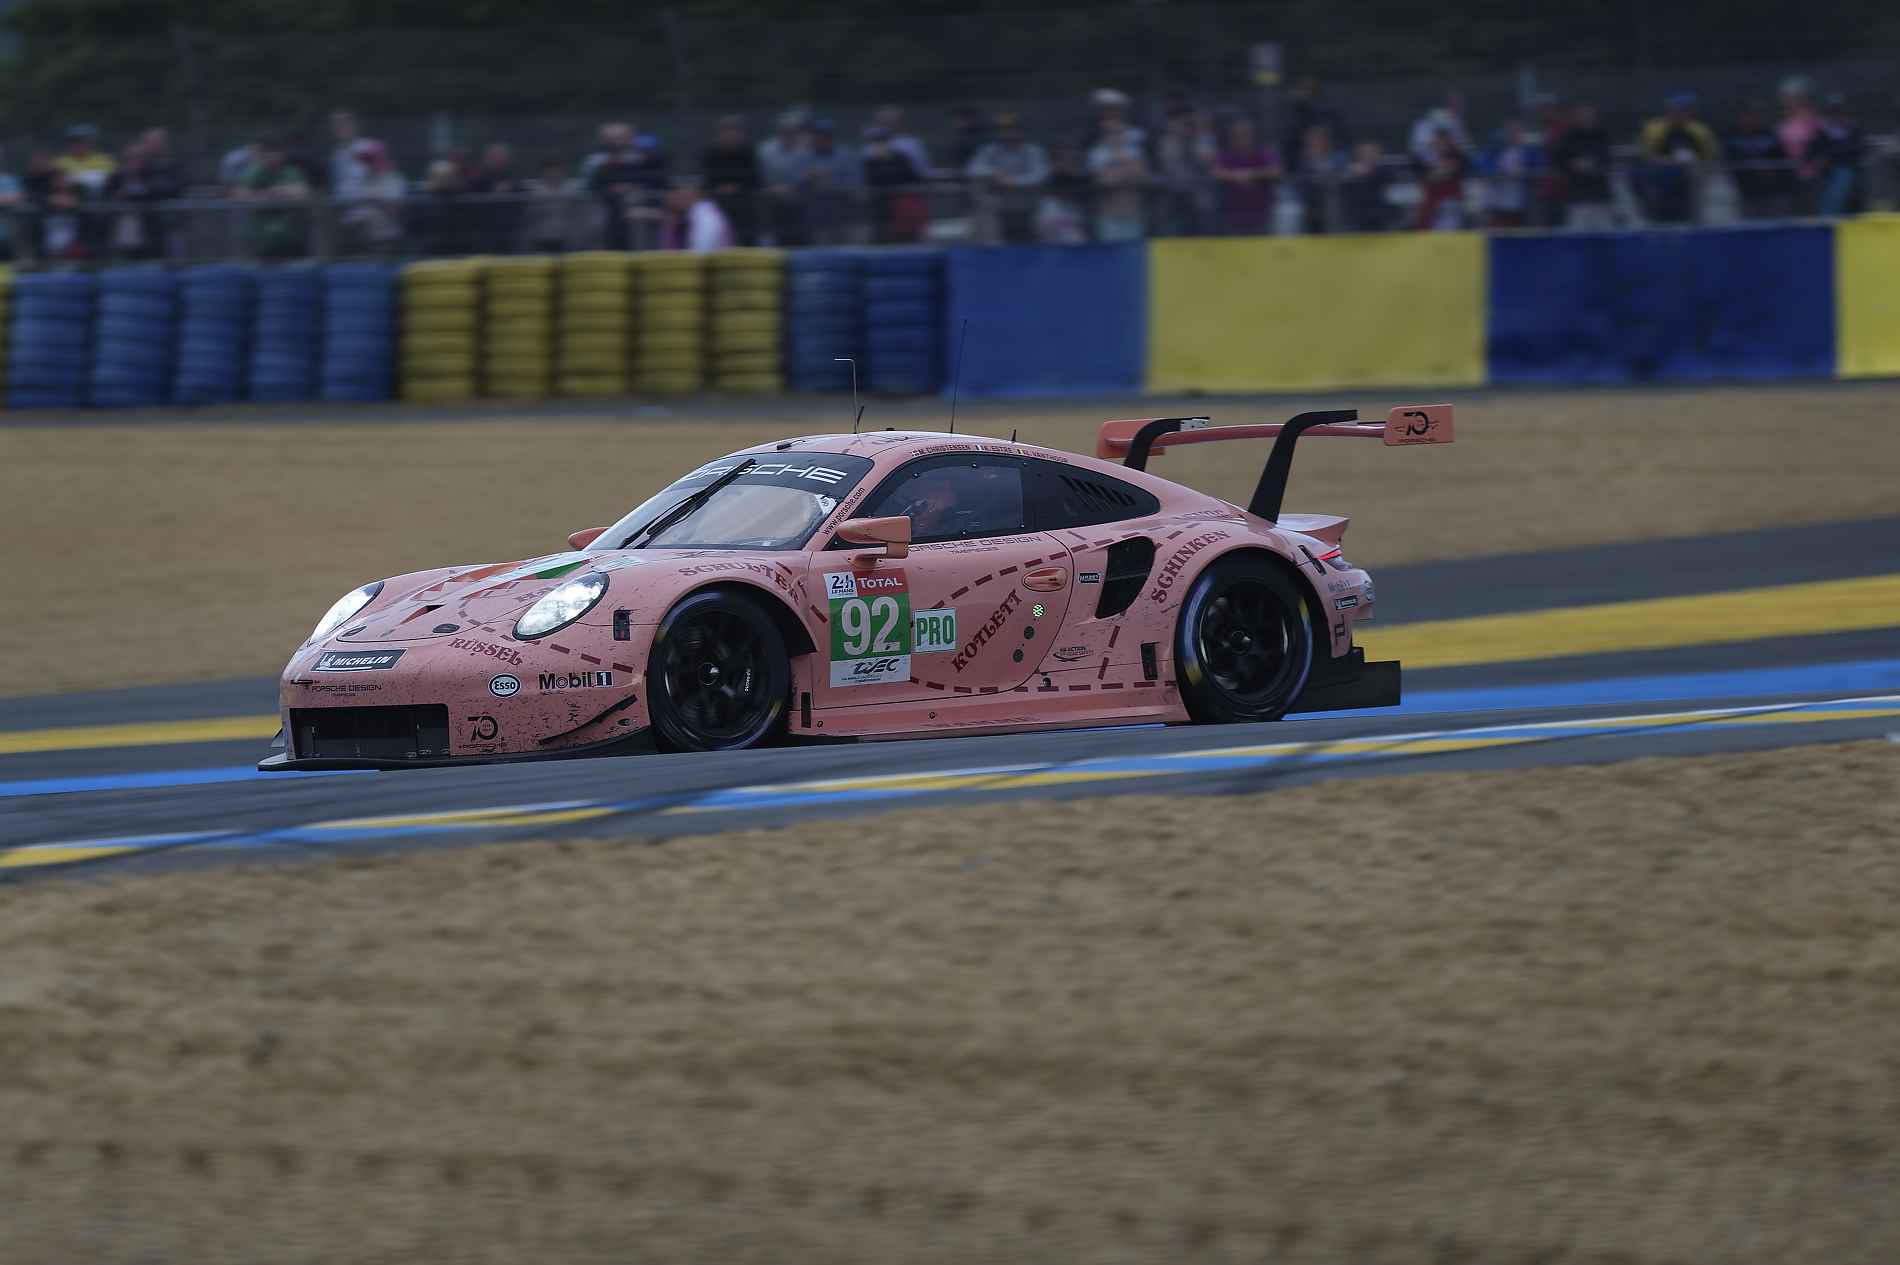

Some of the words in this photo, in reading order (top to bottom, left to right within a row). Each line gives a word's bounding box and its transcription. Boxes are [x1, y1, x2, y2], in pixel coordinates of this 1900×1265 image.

[823, 486, 866, 536] www.porsche.com
[909, 540, 977, 553] ORSCHE
[841, 596, 901, 656] 92
[916, 615, 955, 647] PRO
[951, 589, 1023, 674] KOTLETT
[332, 655, 393, 666] MICHELIN
[538, 673, 593, 690] Mobil
[467, 715, 499, 742] 70
